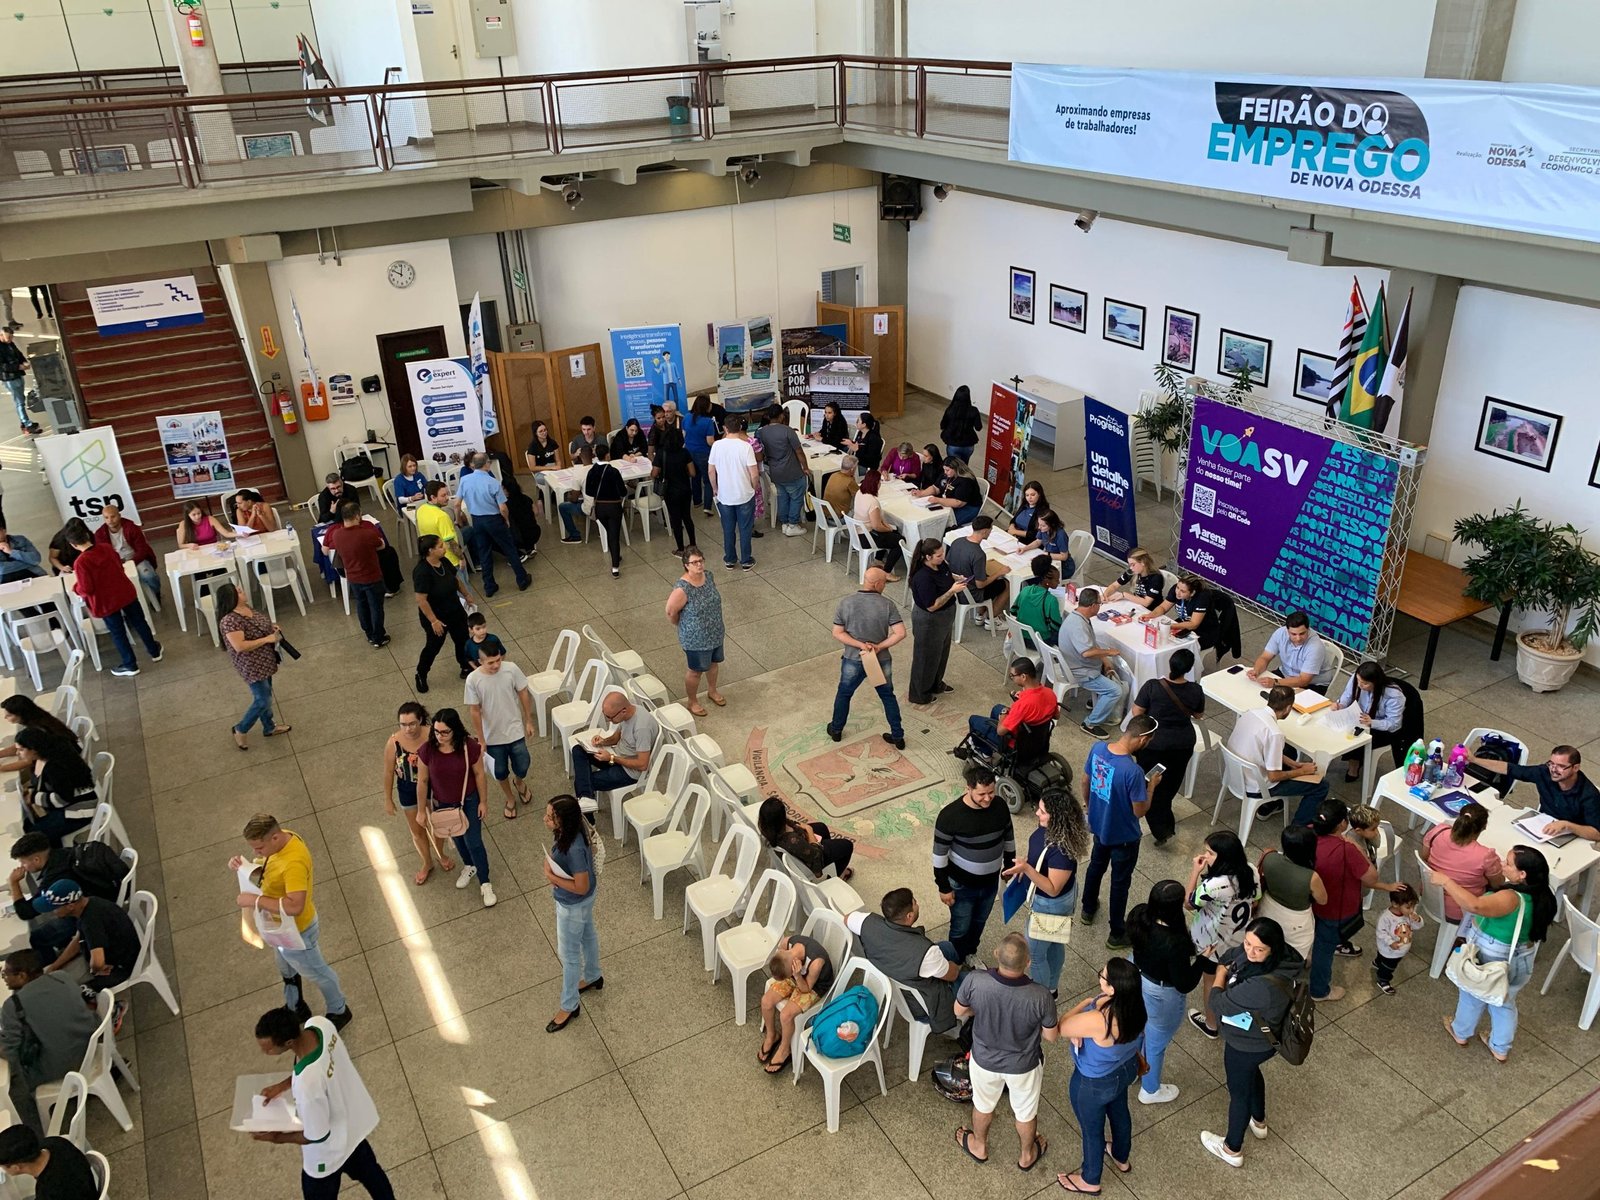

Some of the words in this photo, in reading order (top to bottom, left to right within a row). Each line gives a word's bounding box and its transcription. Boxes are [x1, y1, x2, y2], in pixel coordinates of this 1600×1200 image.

[1055, 103, 1108, 118] Aproximando
[1110, 109, 1151, 121] empresas
[1239, 93, 1335, 127] FEIRÃO
[1065, 118, 1075, 129] de
[1077, 119, 1137, 135] trabalhadores!
[1207, 122, 1430, 182] EMPREGO
[1488, 146, 1517, 157] NOVA
[1486, 156, 1527, 168] ODESSA
[1540, 161, 1593, 174] ECONÔMICO
[1290, 171, 1310, 185] DE
[1312, 174, 1354, 191] NOVA
[1358, 179, 1421, 200] ODESSA
[433, 370, 456, 378] expert
[788, 364, 804, 375] SEU
[788, 375, 805, 386] POR
[816, 376, 856, 386] JOLITEX
[1089, 414, 1124, 437] Progresso
[1091, 451, 1109, 467] Um
[1091, 464, 1129, 489] detalhe
[1196, 466, 1204, 475] do
[1204, 470, 1224, 482] nosso
[1224, 476, 1242, 490] time!
[1197, 456, 1217, 471] Venha
[1217, 463, 1233, 475] fazer
[1233, 471, 1252, 483] parte
[1092, 476, 1123, 497] muda
[1216, 507, 1227, 517] pelo
[1227, 511, 1237, 520] QR
[1236, 515, 1251, 526] Code
[1217, 499, 1247, 516] Inscreva-se
[1201, 528, 1227, 546] arena
[1186, 548, 1202, 562] SV
[1200, 551, 1215, 562] são
[1198, 558, 1227, 576] vicente
[1269, 566, 1352, 611] RESULTADOS
[1231, 901, 1250, 935] 9
